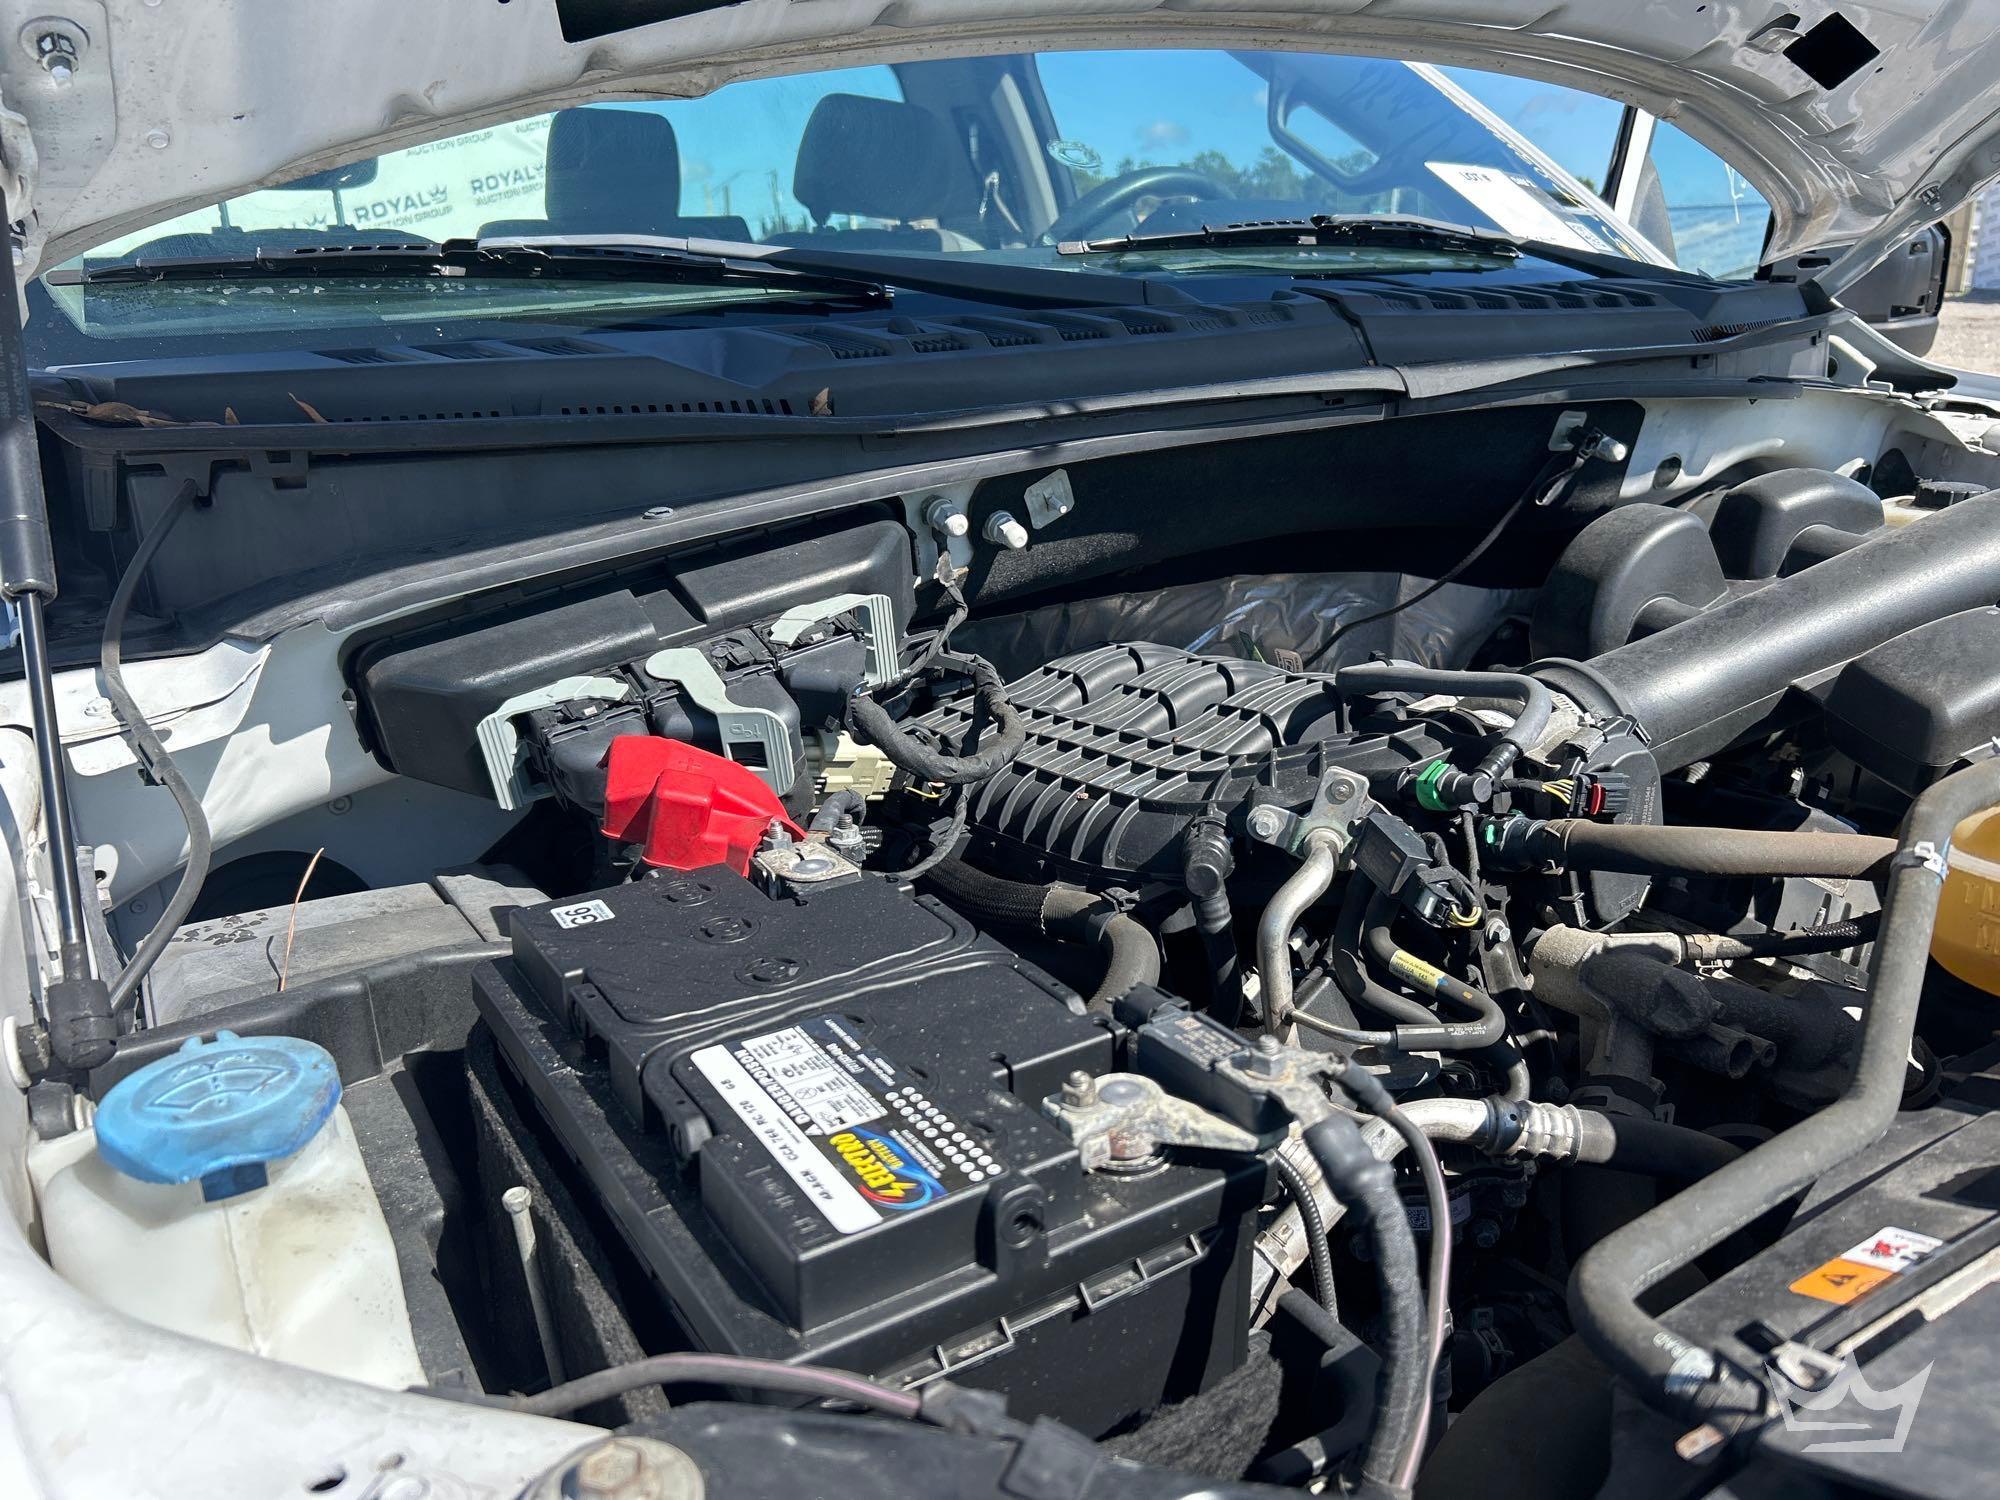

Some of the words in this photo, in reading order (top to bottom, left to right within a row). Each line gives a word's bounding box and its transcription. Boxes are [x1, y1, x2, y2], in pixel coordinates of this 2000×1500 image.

[407, 139, 455, 157] AUCTION
[457, 130, 494, 146] GROUP
[471, 164, 536, 194] ROYAL
[354, 191, 431, 223] ROYAL
[475, 188, 520, 206] AUCTION
[564, 907, 598, 926] G6
[734, 1049, 812, 1126] DANGER/POISON
[752, 1114, 769, 1126] RC
[764, 1129, 784, 1143] 760
[779, 1144, 799, 1161] CCA
[829, 1132, 898, 1189] ELECTRO
[866, 1138, 904, 1170] BATTERY
